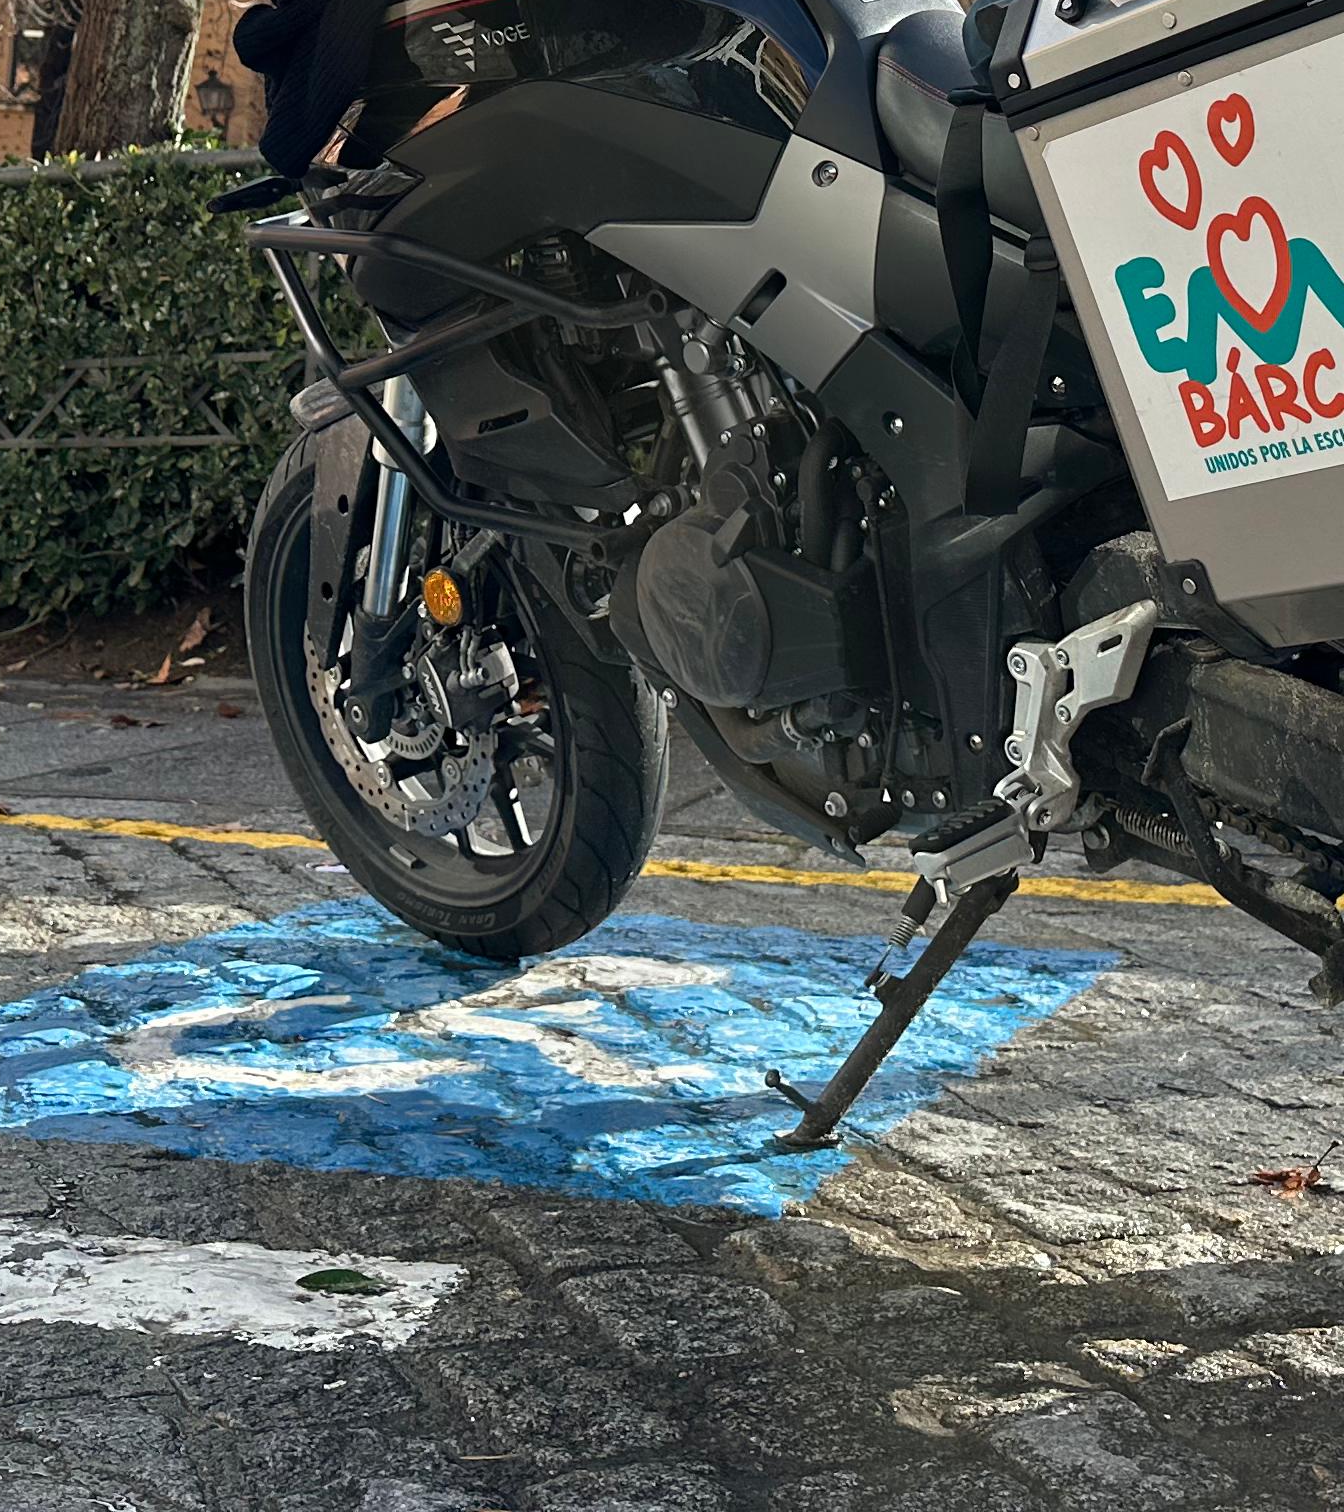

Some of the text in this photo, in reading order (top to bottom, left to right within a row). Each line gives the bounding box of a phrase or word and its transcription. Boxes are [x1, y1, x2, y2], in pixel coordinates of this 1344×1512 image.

[481, 22, 530, 48] VOGE
[1204, 448, 1257, 474] UNIDOS
[1260, 441, 1291, 463] POR
[1294, 436, 1313, 455] LA
